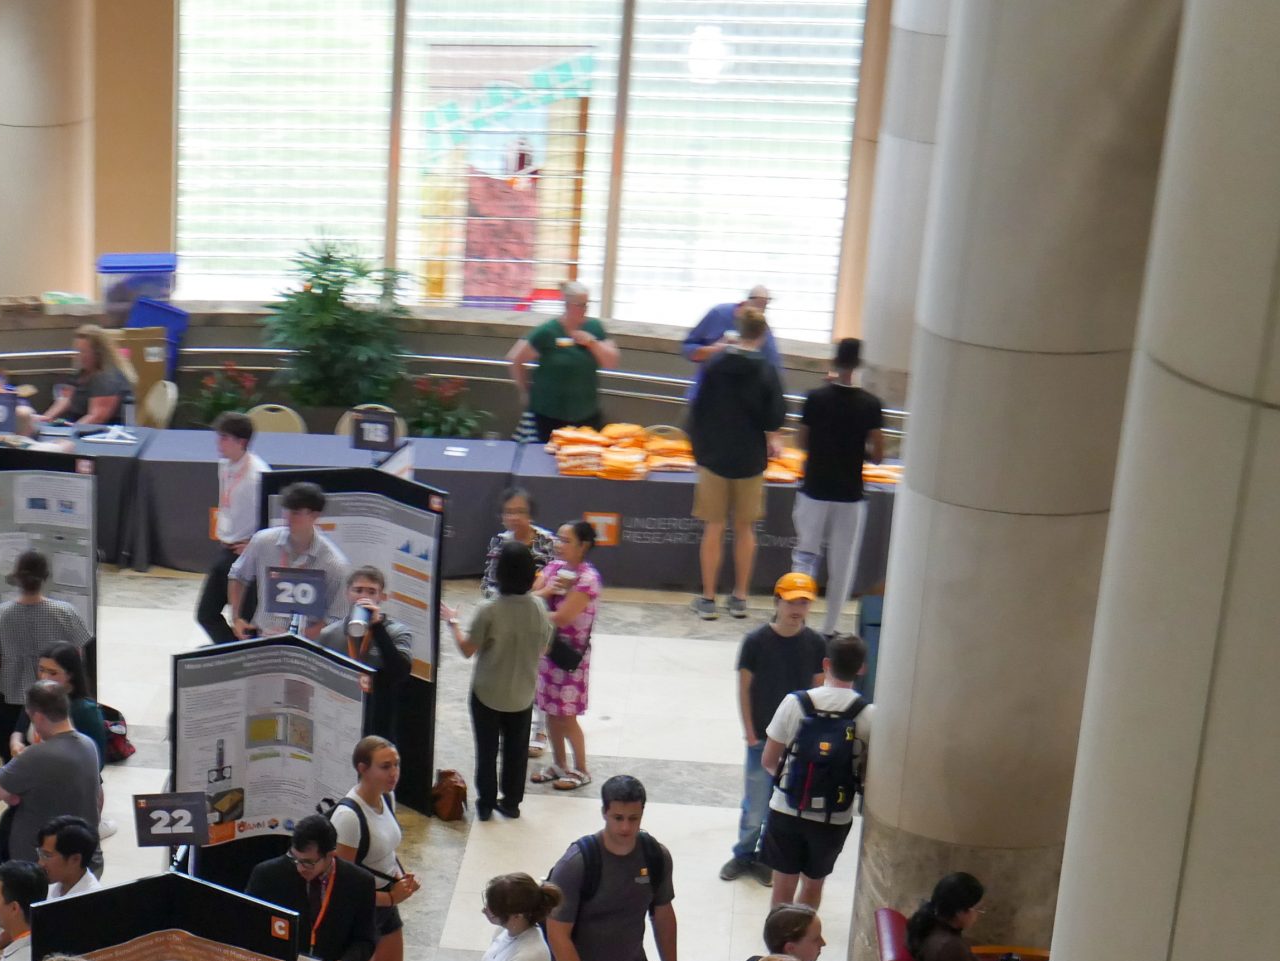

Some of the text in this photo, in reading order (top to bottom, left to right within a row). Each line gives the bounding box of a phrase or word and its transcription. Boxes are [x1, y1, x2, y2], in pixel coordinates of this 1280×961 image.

[275, 581, 317, 604] 20
[149, 809, 193, 834] 22
[274, 920, 286, 935] C
